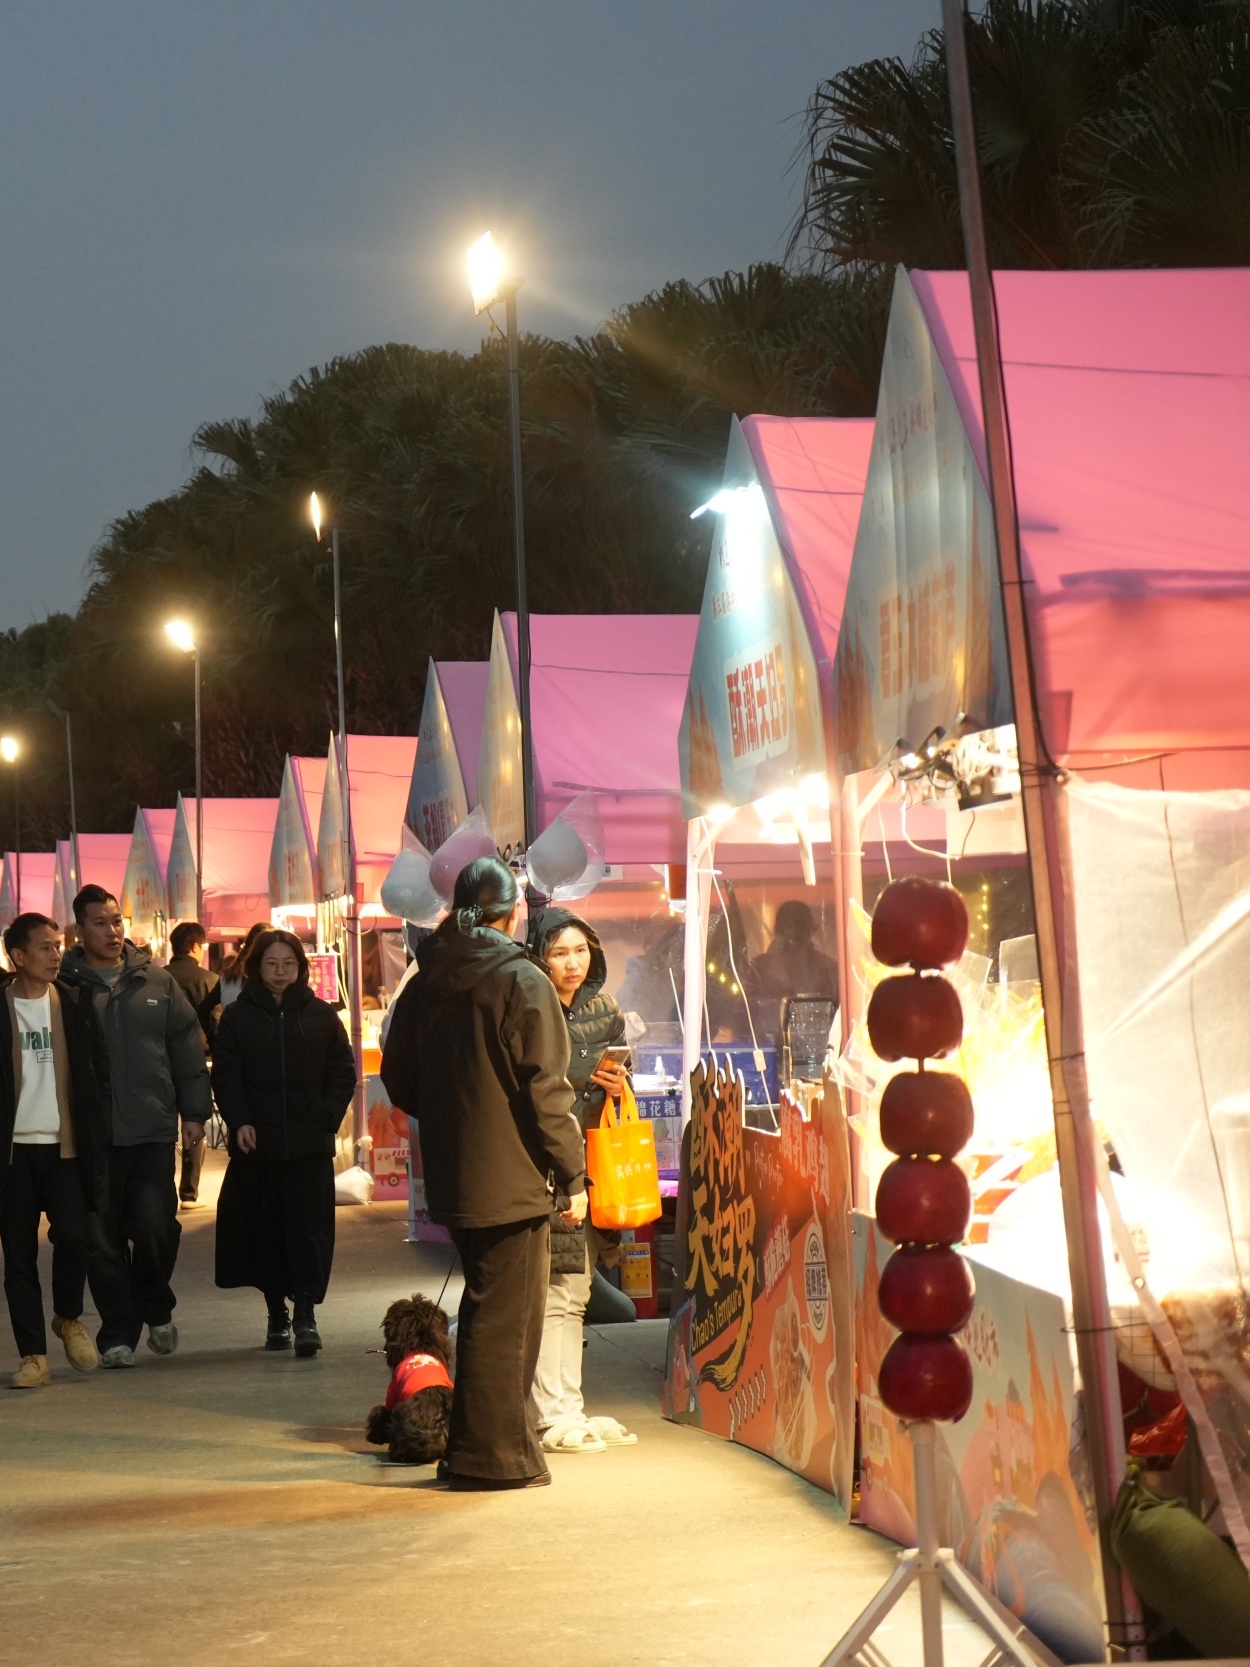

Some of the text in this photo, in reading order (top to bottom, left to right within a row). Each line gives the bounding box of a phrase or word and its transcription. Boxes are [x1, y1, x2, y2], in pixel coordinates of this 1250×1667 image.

[635, 1098, 683, 1118] 棉花糖
[689, 1050, 746, 1197] 酥潮
[684, 1193, 757, 1366] 天妇罗
[690, 1288, 744, 1352] Chao's Tempura
